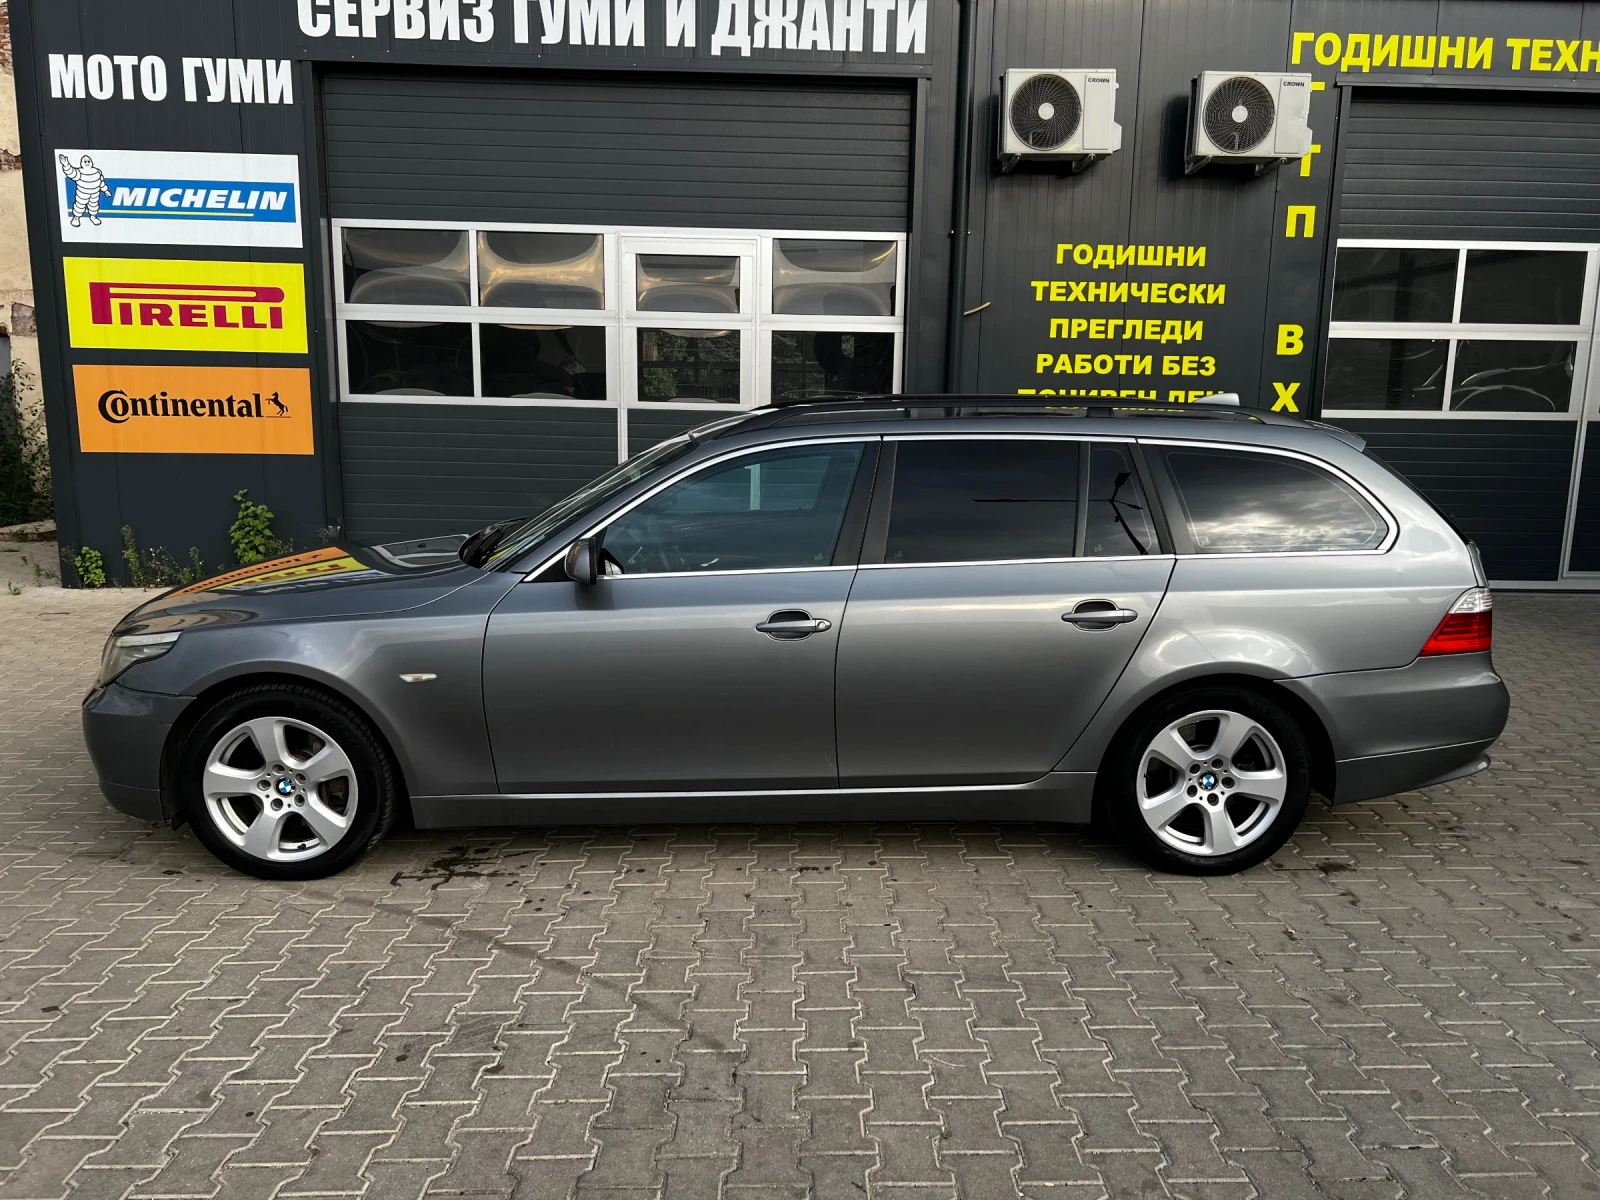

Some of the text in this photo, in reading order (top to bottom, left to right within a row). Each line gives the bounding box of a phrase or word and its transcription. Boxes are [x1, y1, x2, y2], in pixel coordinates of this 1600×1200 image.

[297, 0, 928, 57] СЕРВИЗ ГУМИ И ДЖАНТИ
[1291, 31, 1600, 73] ГОДИШНИ ТЕХН
[48, 53, 294, 105] МОТО ГУМИ
[112, 186, 287, 211] MICHELIN
[1056, 243, 1207, 270] ГОДИШНИ
[89, 281, 285, 329] PIRELLI
[1031, 280, 1226, 305] ТЕХНИЧЕСКИ
[1049, 318, 1204, 345] ПРЕГЛЕДИ
[1036, 353, 1216, 376] РАБОТИ БЕЗ
[98, 389, 265, 424] Continental
